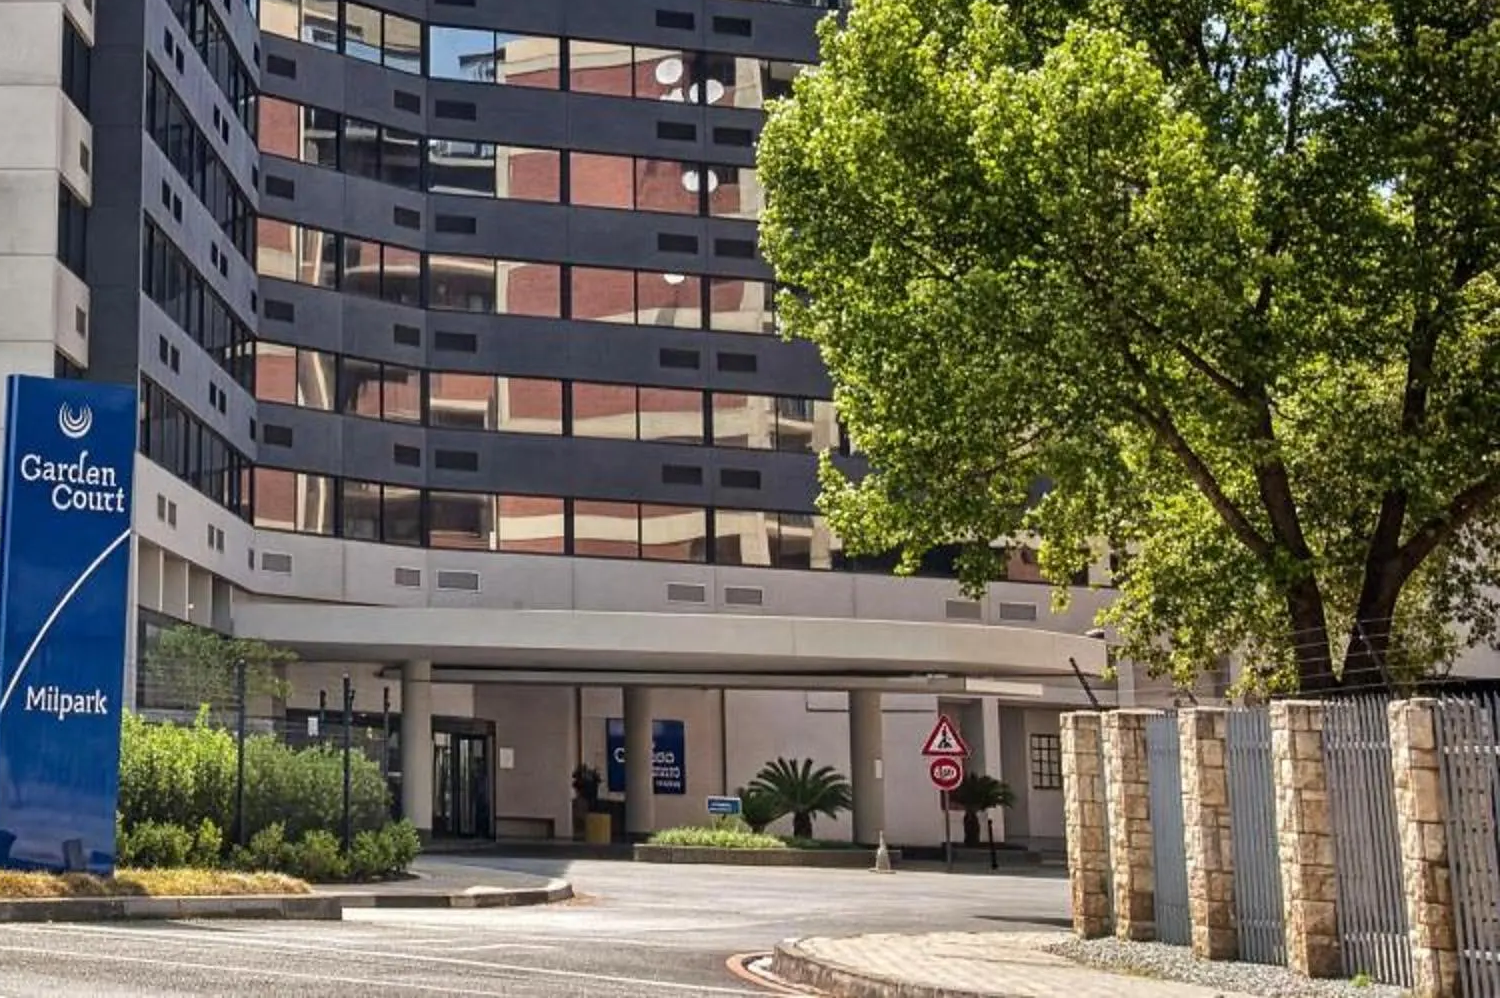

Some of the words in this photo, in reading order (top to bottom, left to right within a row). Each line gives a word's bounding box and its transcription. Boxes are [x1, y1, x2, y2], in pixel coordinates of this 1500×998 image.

[21, 450, 116, 487] Garden
[51, 483, 125, 512] Court
[25, 685, 108, 721] Milpark
